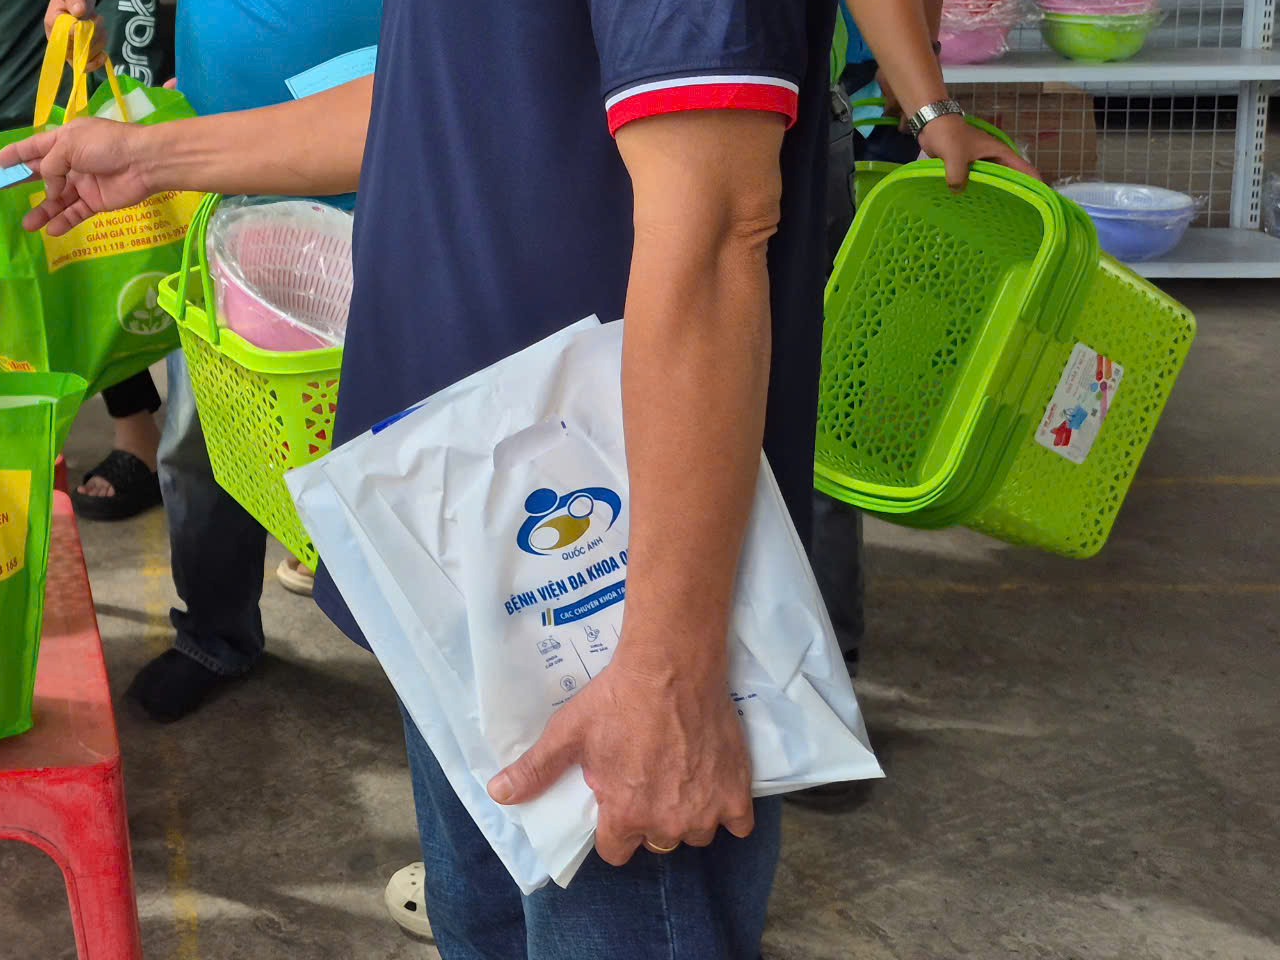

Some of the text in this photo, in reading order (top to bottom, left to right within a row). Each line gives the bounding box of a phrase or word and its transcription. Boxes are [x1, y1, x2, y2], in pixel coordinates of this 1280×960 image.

[561, 545, 586, 561] QUỐC
[504, 590, 539, 616] BỆNH
[537, 578, 569, 602] VIỆN
[567, 570, 588, 591] ĐA
[585, 555, 621, 582] KHOA
